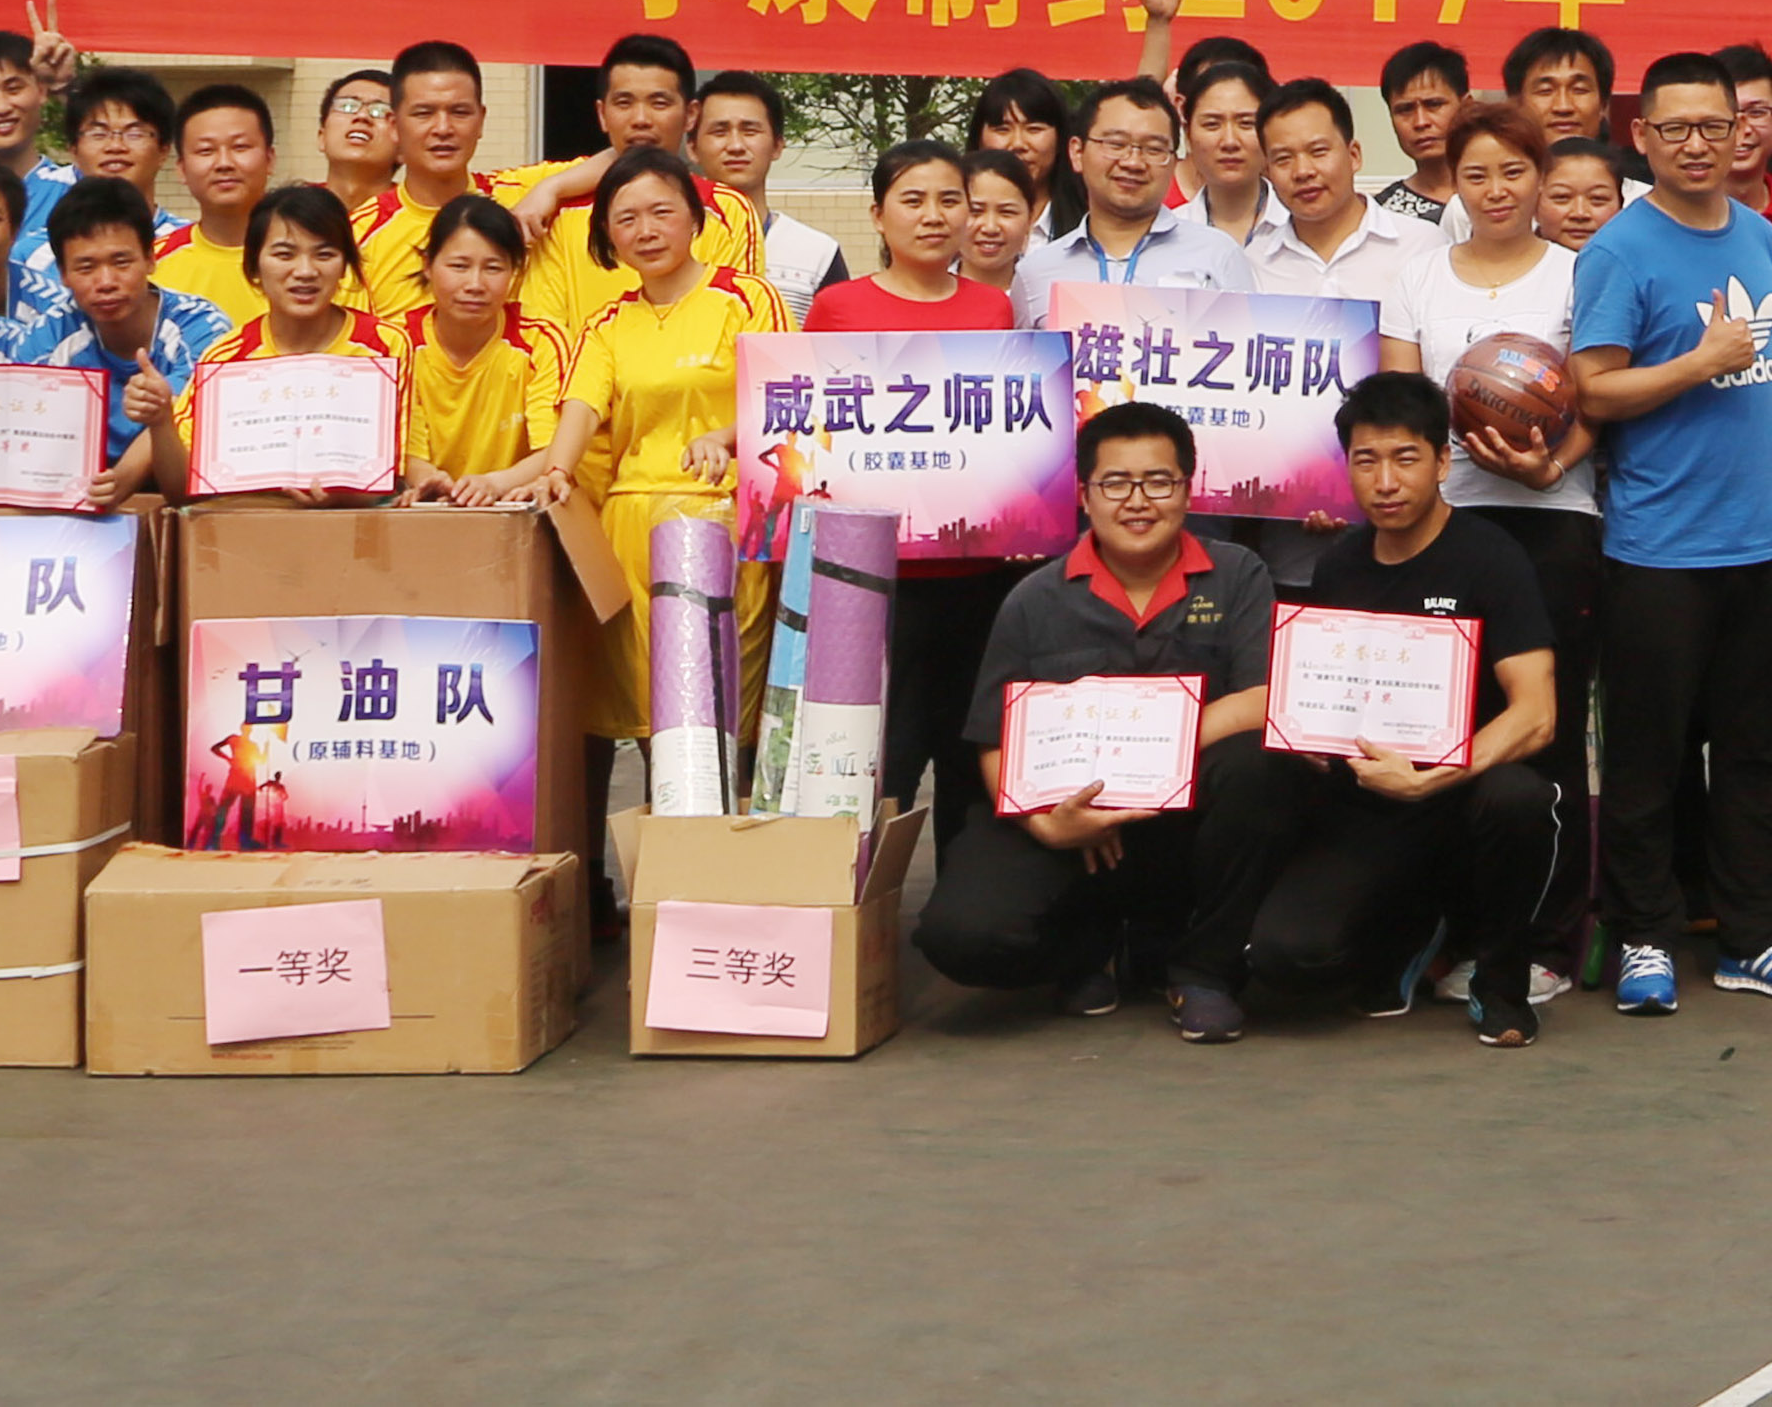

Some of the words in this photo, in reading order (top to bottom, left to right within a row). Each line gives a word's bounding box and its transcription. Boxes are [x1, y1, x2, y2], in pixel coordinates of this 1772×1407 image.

[1075, 322, 1349, 398] 雄壮之师队
[762, 371, 1054, 434] 威武之师队
[1165, 405, 1265, 430] 囊基地）
[239, 659, 494, 725] 甘油队
[292, 739, 436, 762] （原辅料基地）
[238, 948, 352, 986] 一等奖
[686, 948, 796, 987] 三等奖
